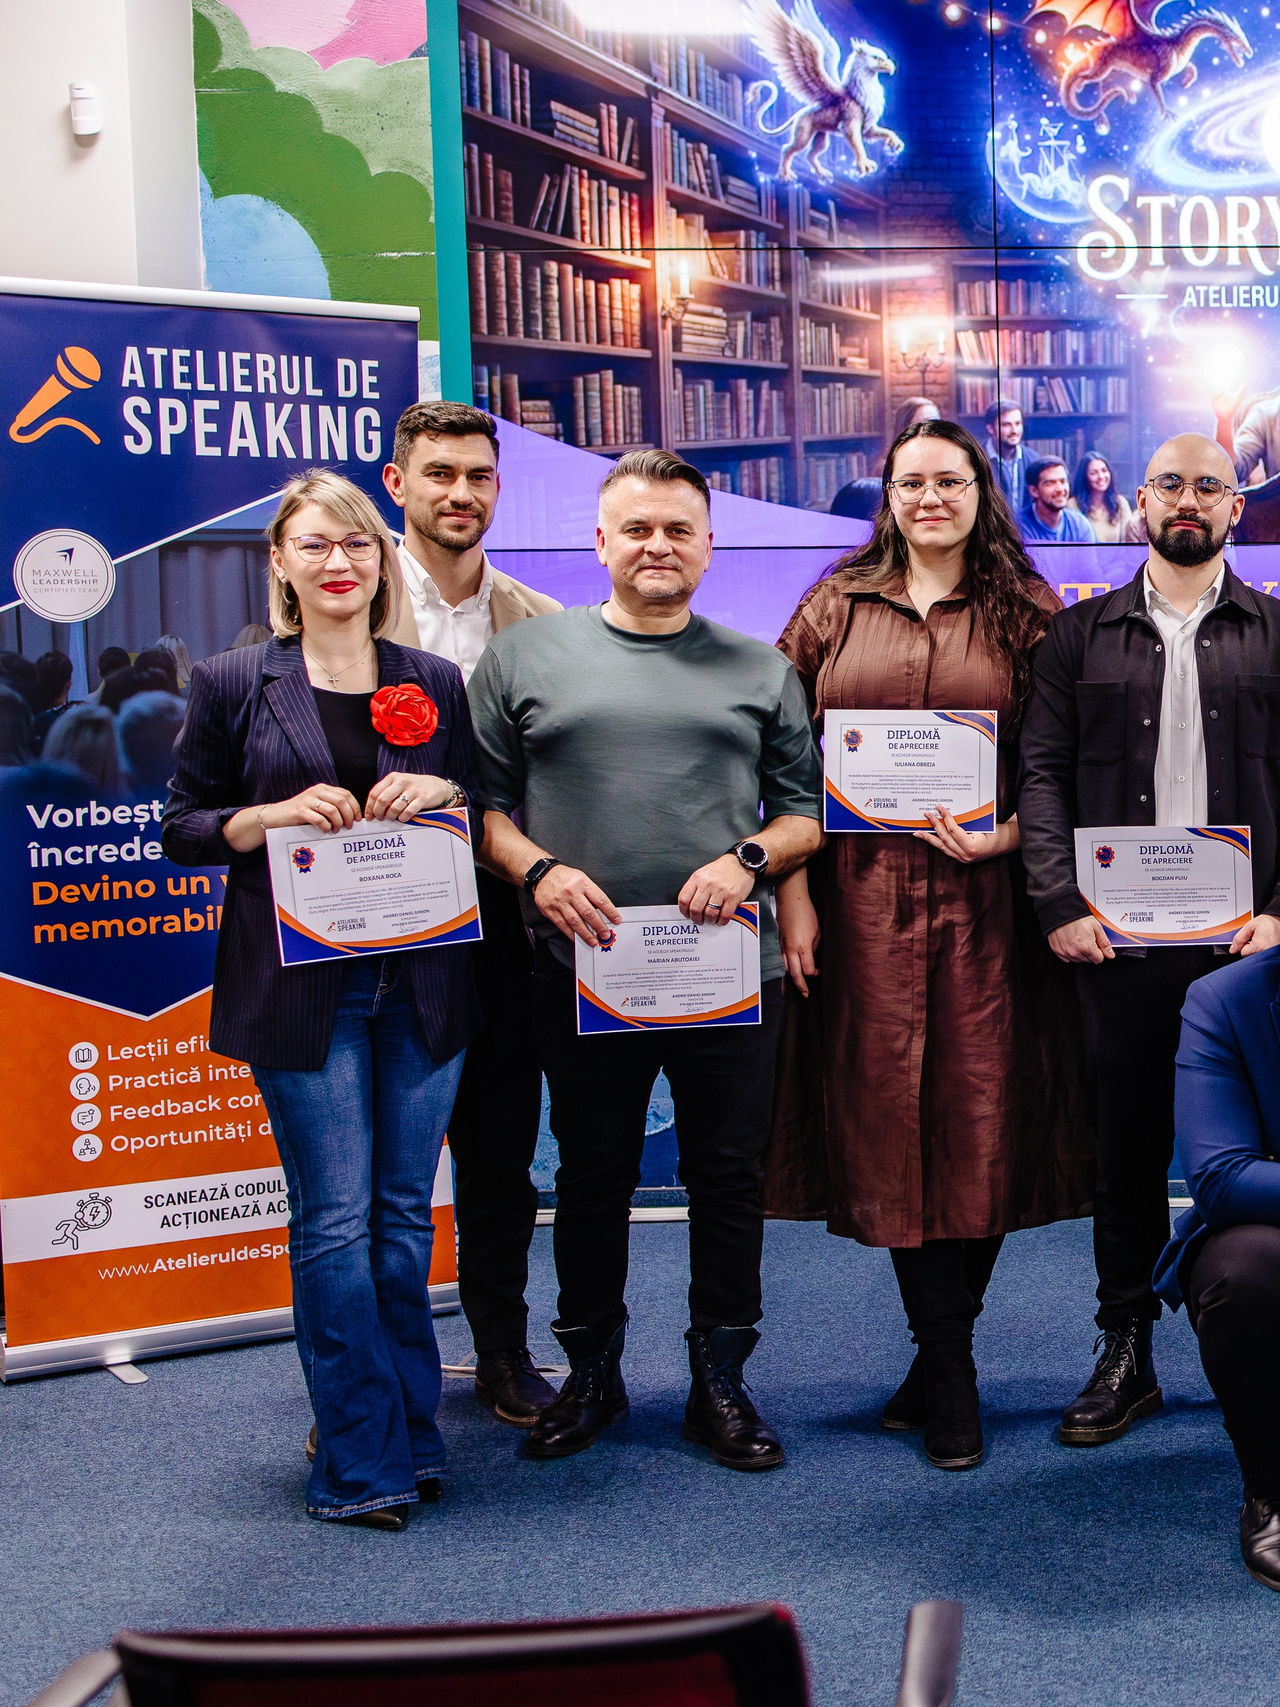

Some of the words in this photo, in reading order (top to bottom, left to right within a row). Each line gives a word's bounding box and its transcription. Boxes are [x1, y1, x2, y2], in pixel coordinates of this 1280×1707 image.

[122, 346, 323, 397] ATELIERUL
[337, 358, 380, 399] DE
[122, 396, 382, 462] SPEAKING
[32, 569, 98, 577] MAXWELL
[887, 728, 941, 740] DIPLOMĂ
[26, 800, 163, 831] Vorbeșt
[27, 836, 164, 868] încrede
[343, 834, 406, 853] DIPLOMĂ
[1139, 843, 1195, 855] DIPLOMĂ
[346, 856, 358, 865] DE
[359, 851, 405, 863] APRECIERE
[32, 874, 156, 906] Devino
[167, 875, 210, 896] un
[359, 873, 385, 882] ROXANA
[34, 905, 223, 944] memorabil
[337, 922, 367, 932] SPEAKING
[644, 939, 655, 947] DE
[656, 937, 699, 946] APRECIERE
[630, 1000, 657, 1008] SPEAKING
[107, 1038, 169, 1062] Lecții
[175, 1035, 211, 1054] efi
[109, 1066, 201, 1091] Practică
[208, 1064, 251, 1082] inte
[110, 1095, 221, 1122] Feedback
[110, 1120, 252, 1154] Oportunități
[258, 1118, 272, 1135] d
[144, 1183, 230, 1209] SCANEAZĂ
[235, 1179, 286, 1198] CODUL
[160, 1200, 262, 1229] ACȚIONEAZĂ
